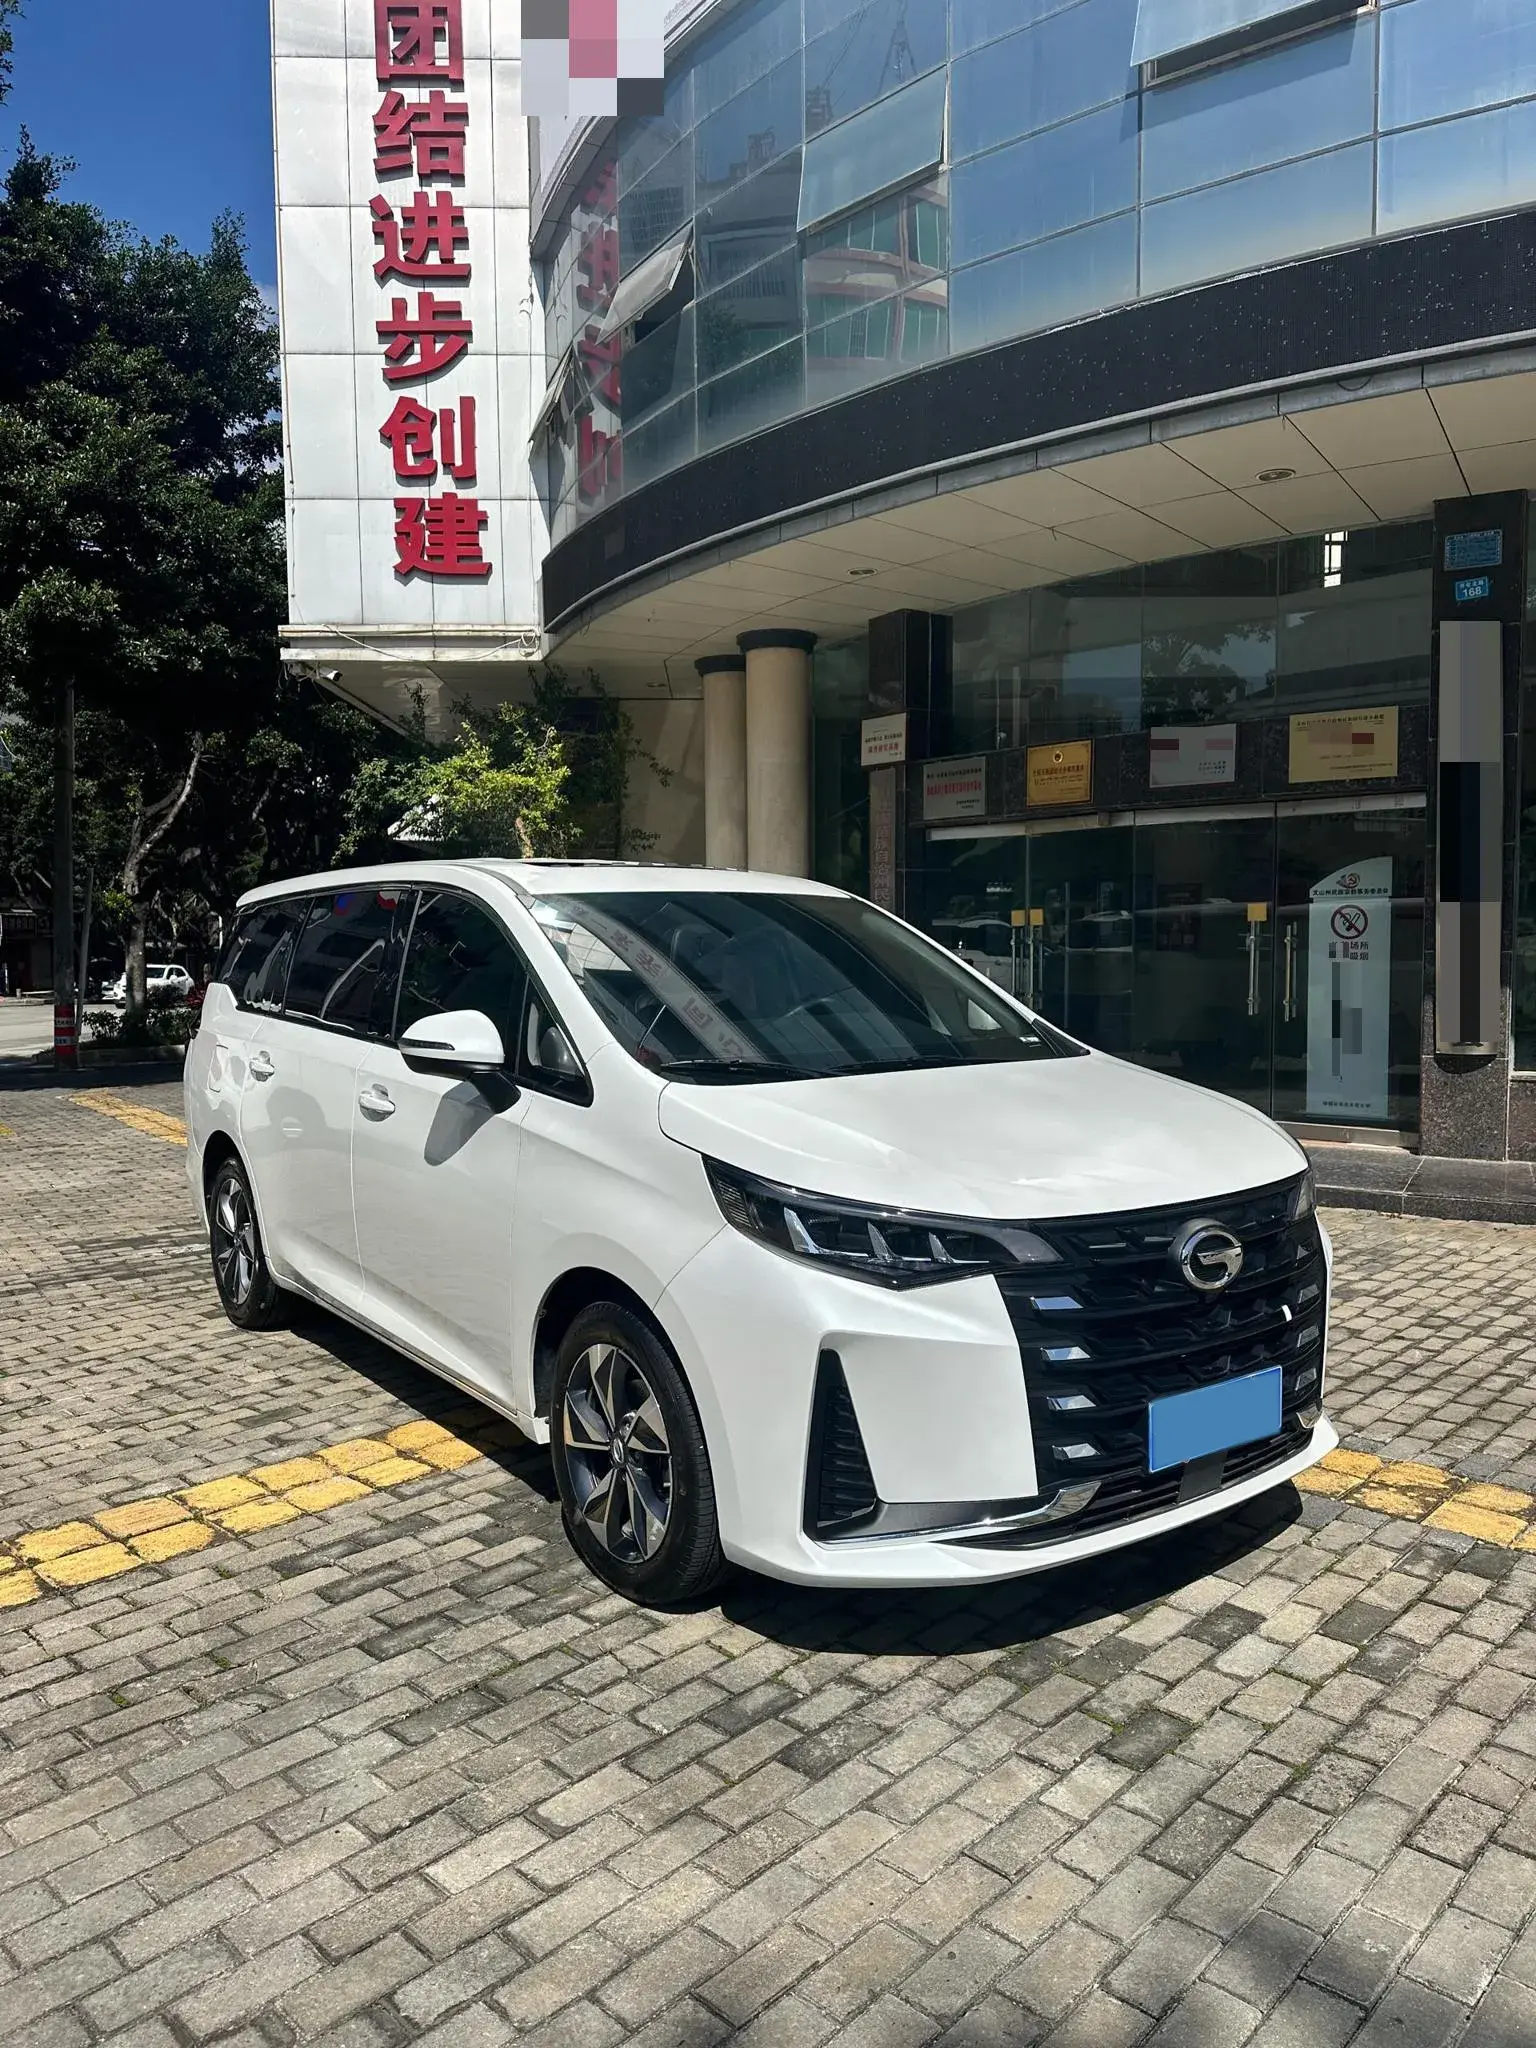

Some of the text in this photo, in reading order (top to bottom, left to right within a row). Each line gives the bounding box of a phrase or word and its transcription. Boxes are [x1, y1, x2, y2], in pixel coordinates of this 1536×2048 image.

[371, 0, 491, 577] 团结进步创建
[1463, 586, 1482, 597] 168
